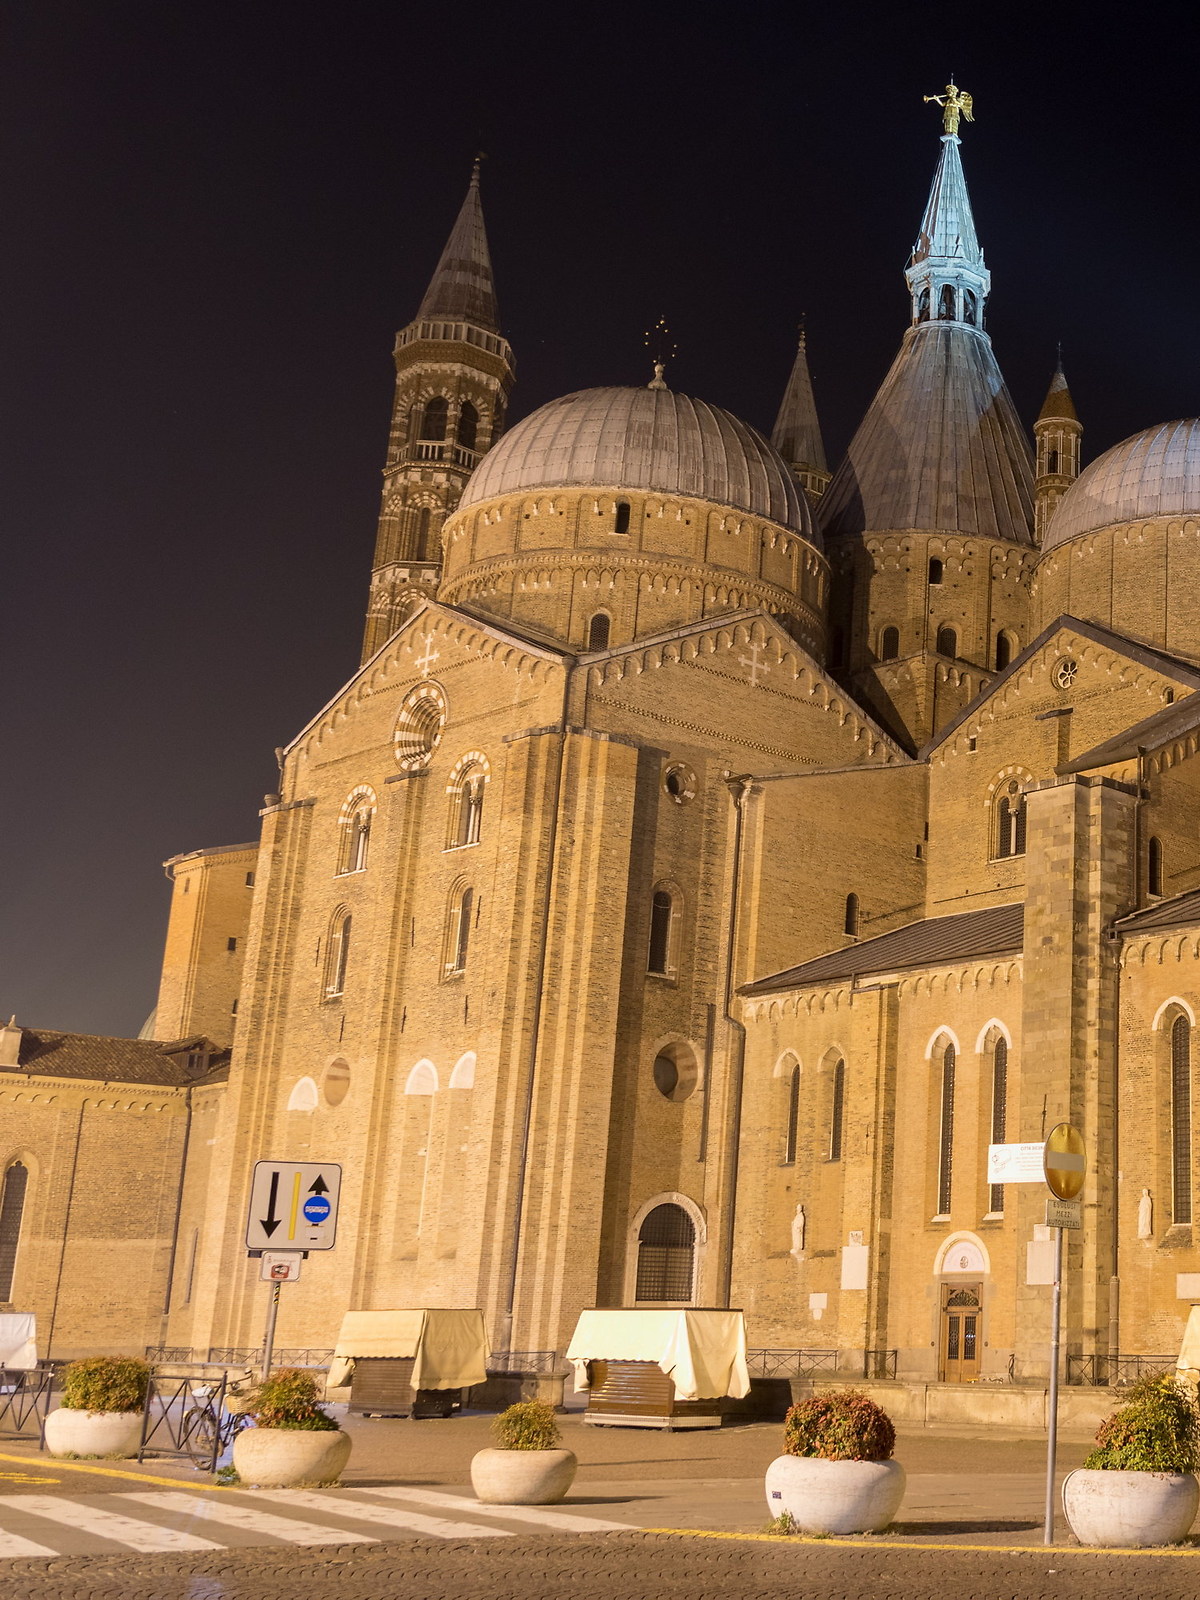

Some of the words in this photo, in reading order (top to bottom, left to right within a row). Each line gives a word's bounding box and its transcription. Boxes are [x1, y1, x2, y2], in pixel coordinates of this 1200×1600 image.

[1053, 1201, 1076, 1210] ESCLUSI
[1056, 1210, 1072, 1218] MEZZI
[1048, 1219, 1080, 1227] AUTORIZZATI
